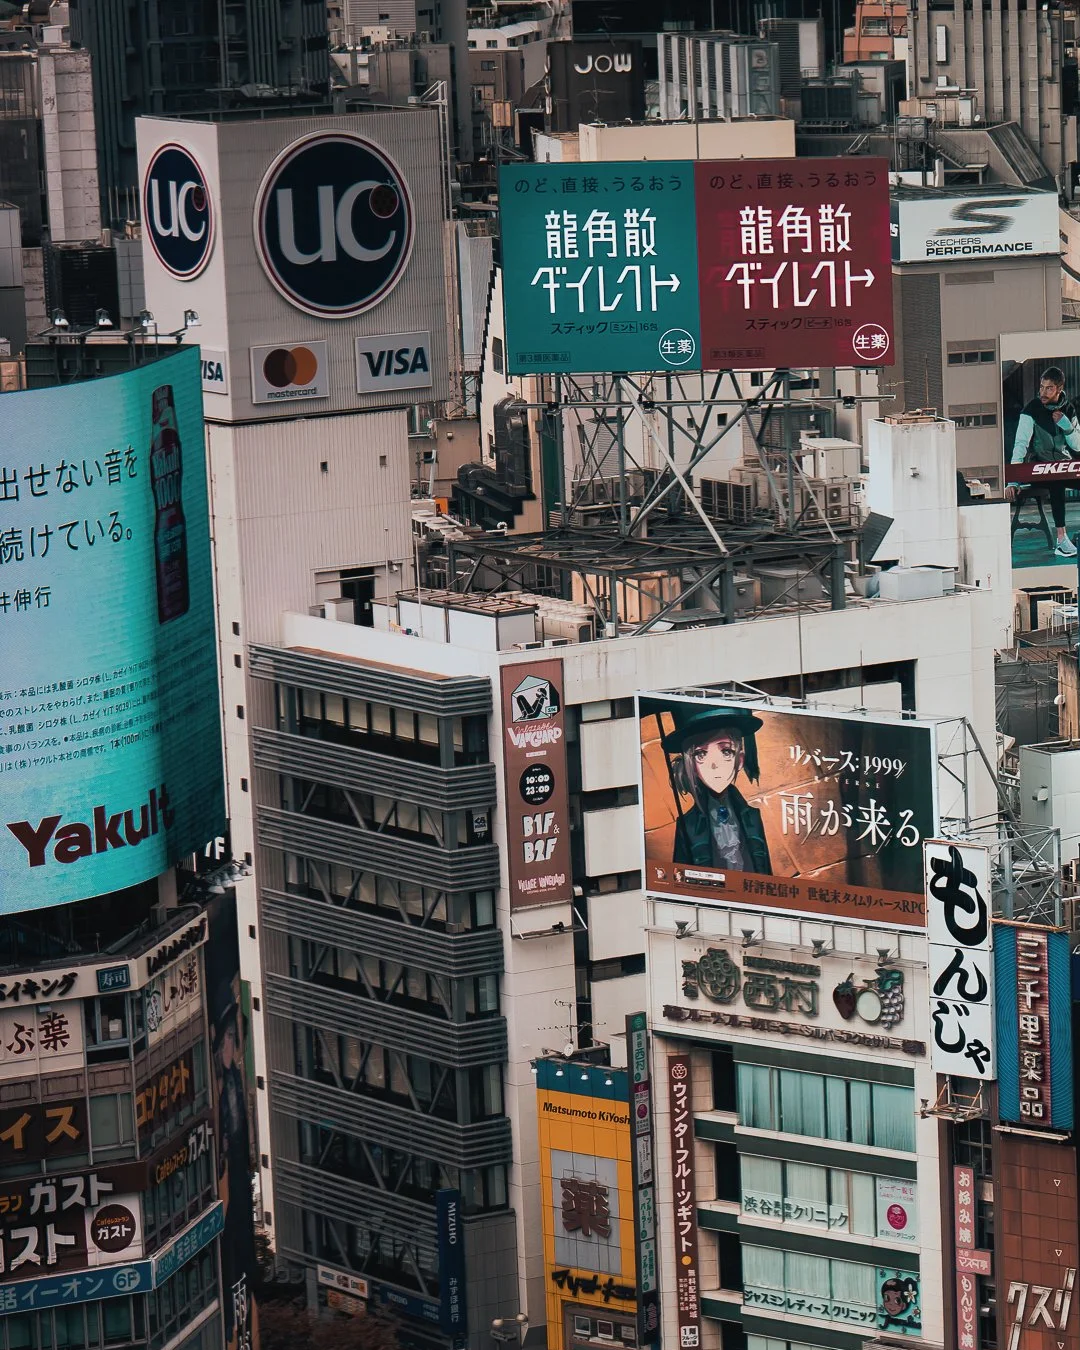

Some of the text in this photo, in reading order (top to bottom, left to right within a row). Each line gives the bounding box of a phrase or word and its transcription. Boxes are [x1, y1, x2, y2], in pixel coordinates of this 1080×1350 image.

[574, 52, 632, 75] JOW
[514, 174, 682, 194] のど、直接、うるおう
[709, 170, 877, 191] のど、直接、うるおう
[544, 207, 658, 260] 龍角散
[739, 203, 853, 256] 龍角散
[925, 237, 981, 248] SKECHERS
[926, 242, 1033, 257] PERFORMANCE
[530, 264, 681, 314] ダイレクト
[725, 259, 875, 310] ダイレクト
[551, 320, 608, 335] スティック
[744, 316, 802, 331] スティック
[661, 338, 692, 356] 生薬
[855, 333, 886, 351] 生薬
[201, 359, 224, 383] ISA
[360, 345, 429, 379] VISA
[266, 386, 318, 400] mastercard
[508, 726, 563, 749] VANGUARD
[6, 783, 175, 868] Yakult
[522, 811, 555, 837] B1F
[777, 790, 920, 850] 雨が来る
[523, 837, 558, 864] B2F
[929, 845, 991, 1074] もんじゃ
[1016, 938, 1043, 1118] 三千里薬品
[543, 1101, 630, 1125] Matsumoto KiYosh
[672, 1082, 693, 1253] ウィンターフルーツギフト
[30, 1174, 114, 1216] ガスト
[560, 1177, 612, 1239] 薬
[447, 1201, 457, 1246] MIZUHO
[0, 1223, 76, 1274] スト
